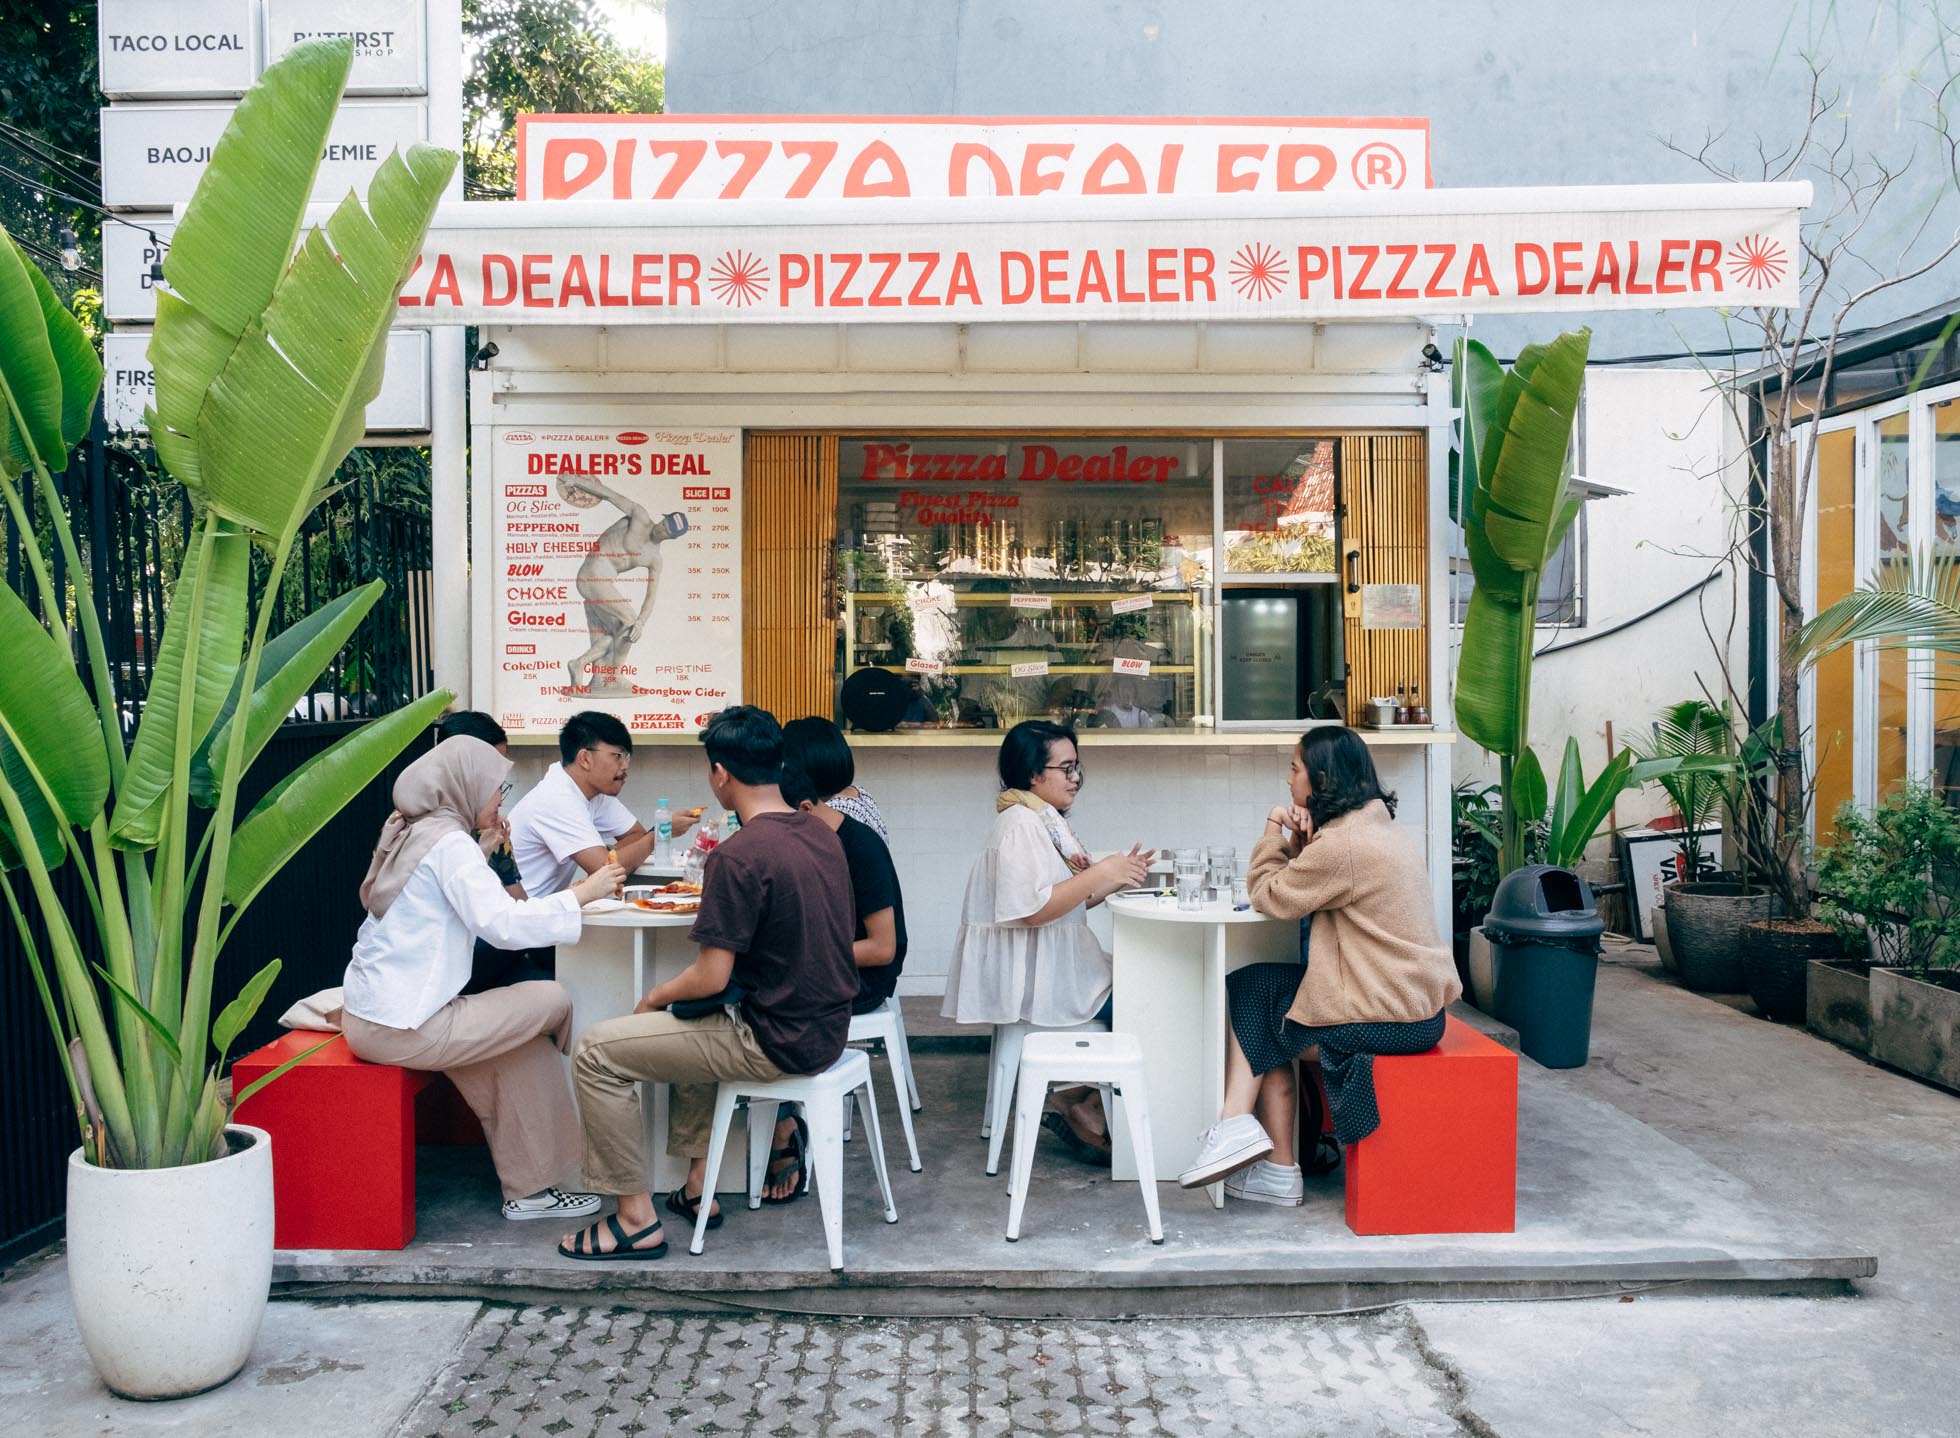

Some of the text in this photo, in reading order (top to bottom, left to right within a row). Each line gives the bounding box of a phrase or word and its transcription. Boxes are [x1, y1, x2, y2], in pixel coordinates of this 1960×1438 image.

[109, 34, 244, 51] TACO LOCAL
[481, 253, 702, 308] DEALER
[779, 252, 983, 307] PIZZZA
[1000, 248, 1217, 305] DEALER
[1298, 243, 1500, 301] PIZZZA
[1514, 239, 1723, 296] DEALER
[527, 453, 711, 475] DEALER'S DEAL
[860, 443, 1179, 483] Pizzza Dealer
[506, 486, 545, 496] PIZZZAS
[685, 489, 727, 498] SLICE PIE
[899, 491, 962, 507] Finest
[506, 500, 561, 513] OG Slice
[917, 508, 993, 528] Quality
[507, 523, 580, 532] PEPPERONI
[505, 542, 600, 553] HOLY CHEESUS
[507, 564, 544, 576] BLOW
[507, 586, 568, 600] CHOKE
[507, 610, 566, 626] Glazed
[502, 661, 561, 671] Coke/Diet
[583, 663, 638, 676] Ginger Ale
[655, 664, 713, 674] PRISTINE
[910, 659, 939, 670] Glazed
[1121, 660, 1143, 669] BLOW
[540, 685, 592, 695] BINTANG
[631, 685, 727, 697] Strongbow Cider
[531, 717, 558, 725] PIZZZA
